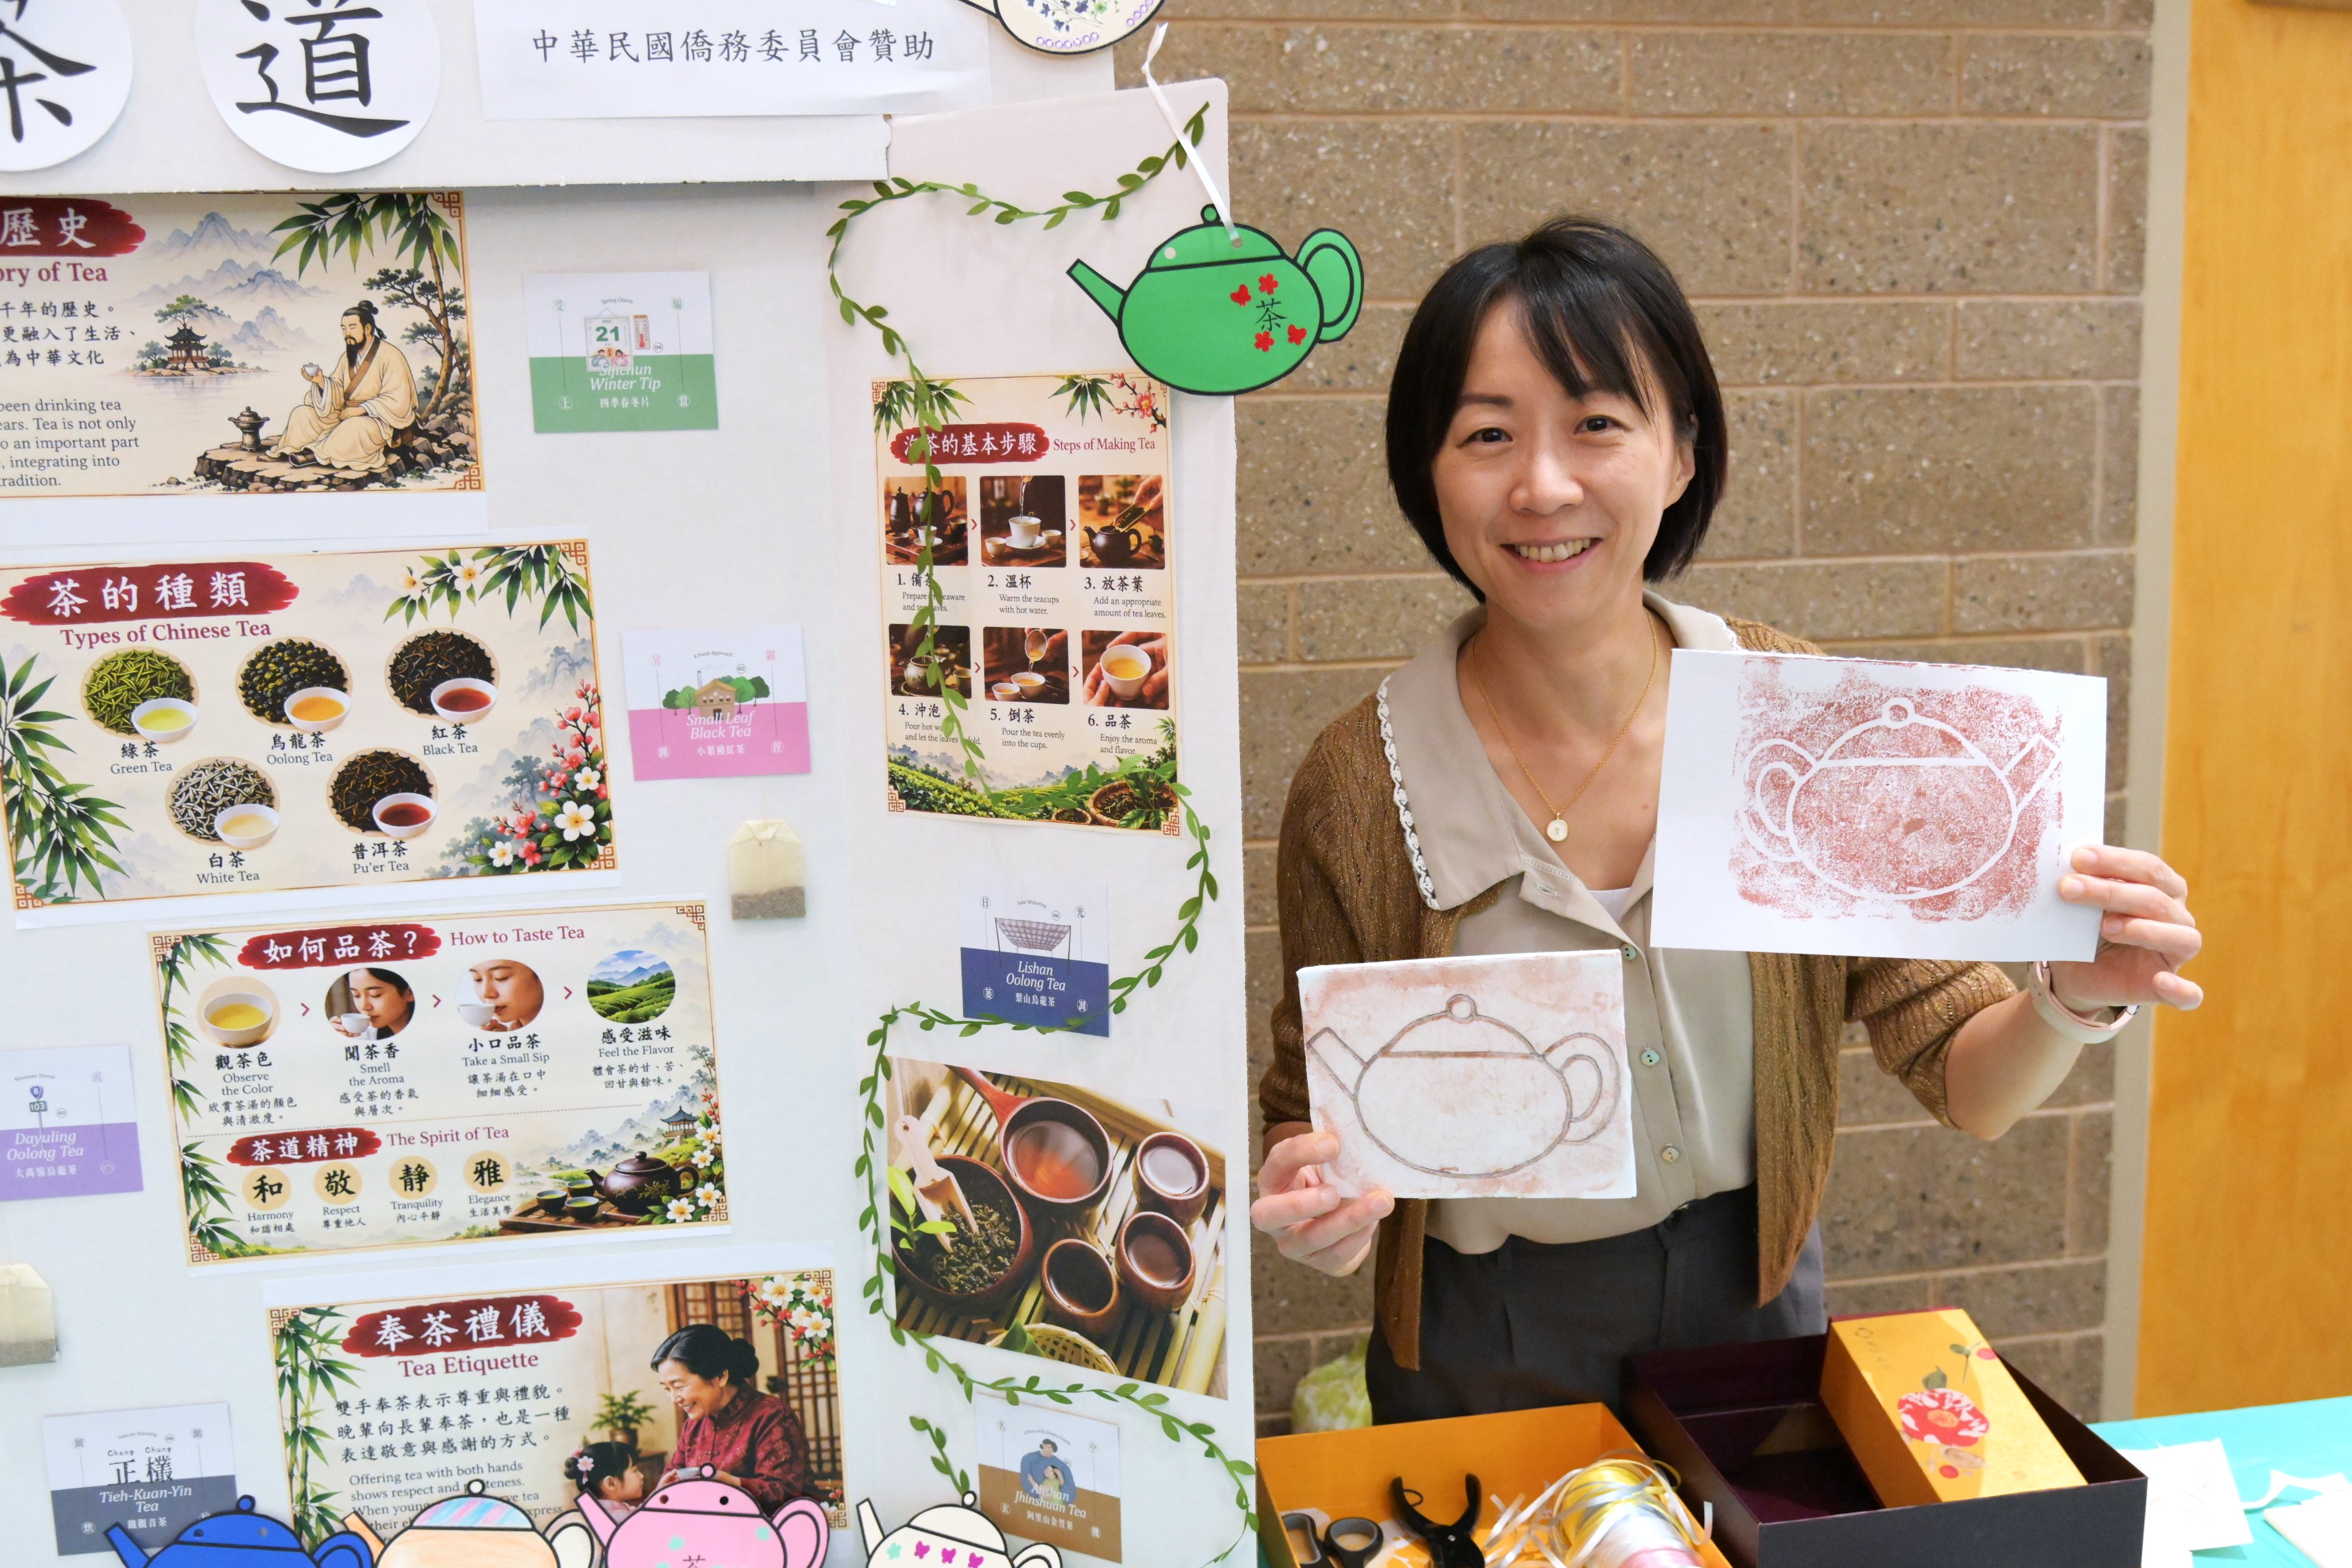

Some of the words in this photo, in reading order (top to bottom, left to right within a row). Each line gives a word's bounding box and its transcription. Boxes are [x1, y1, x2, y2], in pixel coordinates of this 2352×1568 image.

[533, 29, 934, 63] 中華民國僑務委員會贊助
[236, 0, 411, 138] 道
[0, 208, 96, 248] 歷史
[38, 262, 60, 281] of
[67, 263, 108, 281] Tea
[0, 301, 114, 318] 千年的歷史。
[1256, 298, 1287, 332] 茶
[2, 326, 135, 342] 更融入了生活、
[596, 326, 619, 341] 21
[599, 364, 651, 379] Sijichun
[591, 378, 636, 390] Winter
[640, 377, 661, 392] Tip
[36, 399, 97, 414] drinking
[101, 400, 121, 410] tea
[600, 397, 649, 409] 四季春冬片
[14, 441, 31, 449] an
[36, 437, 106, 452] important
[111, 437, 139, 451] part
[1053, 438, 1081, 453] Steps
[1083, 438, 1094, 450] of
[1097, 438, 1136, 453] Making
[1138, 438, 1155, 449] Tea
[10, 456, 88, 470] integrating
[93, 455, 120, 467] into
[47, 571, 249, 617] 茶的種類
[903, 592, 927, 601] Prepare
[999, 594, 1020, 602] Warm
[1022, 594, 1032, 602] the
[1034, 596, 1059, 605] teacups
[1122, 598, 1161, 606] appropriate
[1145, 610, 1166, 619] leaves.
[60, 629, 120, 649] Types
[127, 625, 147, 642] of
[153, 624, 230, 641] Chinese
[236, 621, 271, 636] Tea
[899, 704, 909, 715] 4.
[916, 703, 941, 717] 沖泡
[687, 713, 722, 725] Small
[726, 712, 755, 726] Leaf
[1088, 714, 1098, 726] 6.
[1105, 714, 1131, 729] 品茶
[432, 724, 468, 740] 紅茶
[691, 727, 725, 739] Black
[729, 726, 751, 737] Tea
[1044, 731, 1065, 740] evenly
[1100, 733, 1120, 745] Enjoy
[271, 732, 326, 750] 烏龍茶
[121, 741, 159, 759] 綠茶
[423, 745, 454, 755] Black
[458, 743, 478, 753] Tea
[1115, 747, 1136, 755] flavor.
[267, 753, 309, 766] Oolong
[314, 752, 333, 762] Tea
[110, 763, 147, 774] Green
[150, 762, 172, 772] Tea
[352, 841, 409, 861] 普洱茶
[209, 851, 246, 868] 白茶
[354, 863, 386, 874] Pu'er
[390, 861, 409, 871] Tea
[196, 873, 235, 884] White
[237, 872, 259, 882] Tea
[450, 931, 487, 946] How
[493, 932, 508, 943] to
[515, 929, 553, 942] Taste
[558, 926, 584, 939] Tea
[263, 931, 417, 963] 如何品茶？
[1018, 961, 1053, 976] Lishan
[1007, 973, 1043, 991] Oolong
[1047, 977, 1066, 991] Tea
[1015, 993, 1055, 1007] 梨山烏龍茶
[468, 1033, 541, 1052] 小口品茶
[601, 1026, 672, 1044] 感受滋味
[344, 1043, 400, 1061] 聞茶香
[599, 1047, 619, 1058] Feel
[624, 1047, 639, 1055] the
[642, 1045, 674, 1055] Flavor
[216, 1052, 272, 1070] 觀茶色
[462, 1056, 488, 1067] Take
[500, 1053, 530, 1065] Small
[533, 1053, 549, 1063] Sip
[360, 1063, 390, 1073] Smell
[223, 1073, 269, 1083] Observe
[349, 1077, 365, 1086] the
[369, 1076, 404, 1085] Aroma
[468, 1070, 546, 1085] 讓茶湯在口中
[222, 1086, 239, 1095] the
[243, 1085, 273, 1094] Color
[339, 1088, 419, 1103] 感受茶的香氣
[31, 1102, 45, 1110] 103
[16, 1131, 76, 1146] Dayuling
[387, 1133, 415, 1147] The
[420, 1130, 460, 1146] Spirit
[465, 1128, 480, 1140] of
[483, 1127, 509, 1139] Tea
[7, 1148, 56, 1161] Oolong
[60, 1145, 84, 1157] Tea
[251, 1131, 358, 1163] 茶道精神
[399, 1164, 430, 1192] 靜
[473, 1158, 503, 1186] 雅
[253, 1174, 283, 1203] 和
[324, 1169, 356, 1197] 敬
[390, 1199, 443, 1210] Tranquility
[469, 1194, 510, 1204] Elegance
[248, 1211, 294, 1221] Harmony
[323, 1206, 360, 1216] Respect
[250, 1222, 295, 1234] 和諧相處
[322, 1217, 366, 1229] 尊重他人
[375, 1300, 550, 1352] 奉茶禮儀
[398, 1360, 436, 1378] Tea
[443, 1354, 539, 1376] Etiquette
[341, 1433, 549, 1463] 表達敬意與感謝的方式。
[349, 1473, 401, 1486] Offering
[405, 1473, 422, 1481] tea
[427, 1467, 453, 1478] with
[457, 1464, 483, 1476] both
[487, 1461, 523, 1473] hands
[100, 1486, 191, 1503] Tieh-Kuan-Yin
[351, 1491, 388, 1501] shows
[392, 1486, 433, 1498] respect
[438, 1481, 459, 1493] and
[1031, 1484, 1069, 1501] Alishan
[136, 1501, 158, 1512] Tea
[1014, 1490, 1066, 1512] Jhinshuan
[1068, 1504, 1086, 1518] Tea
